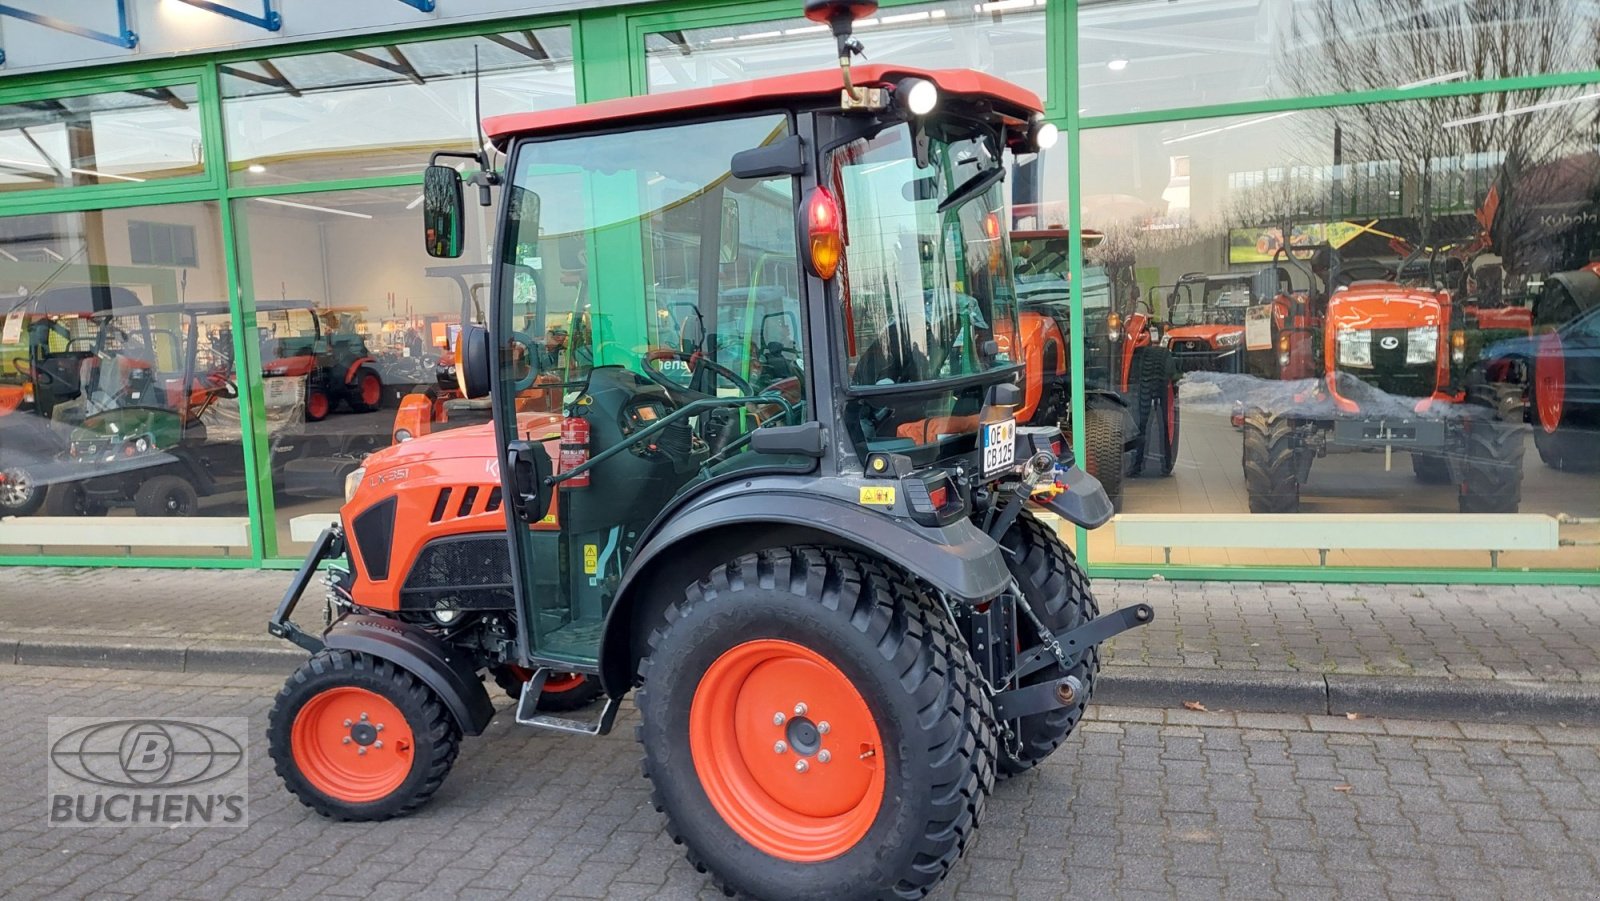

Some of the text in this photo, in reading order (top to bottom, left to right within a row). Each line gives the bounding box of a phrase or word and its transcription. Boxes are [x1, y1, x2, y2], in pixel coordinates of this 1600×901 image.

[1540, 211, 1598, 227] Kubota
[991, 425, 1002, 446] OE
[986, 442, 1013, 469] CB 125
[369, 467, 410, 487] LX-351
